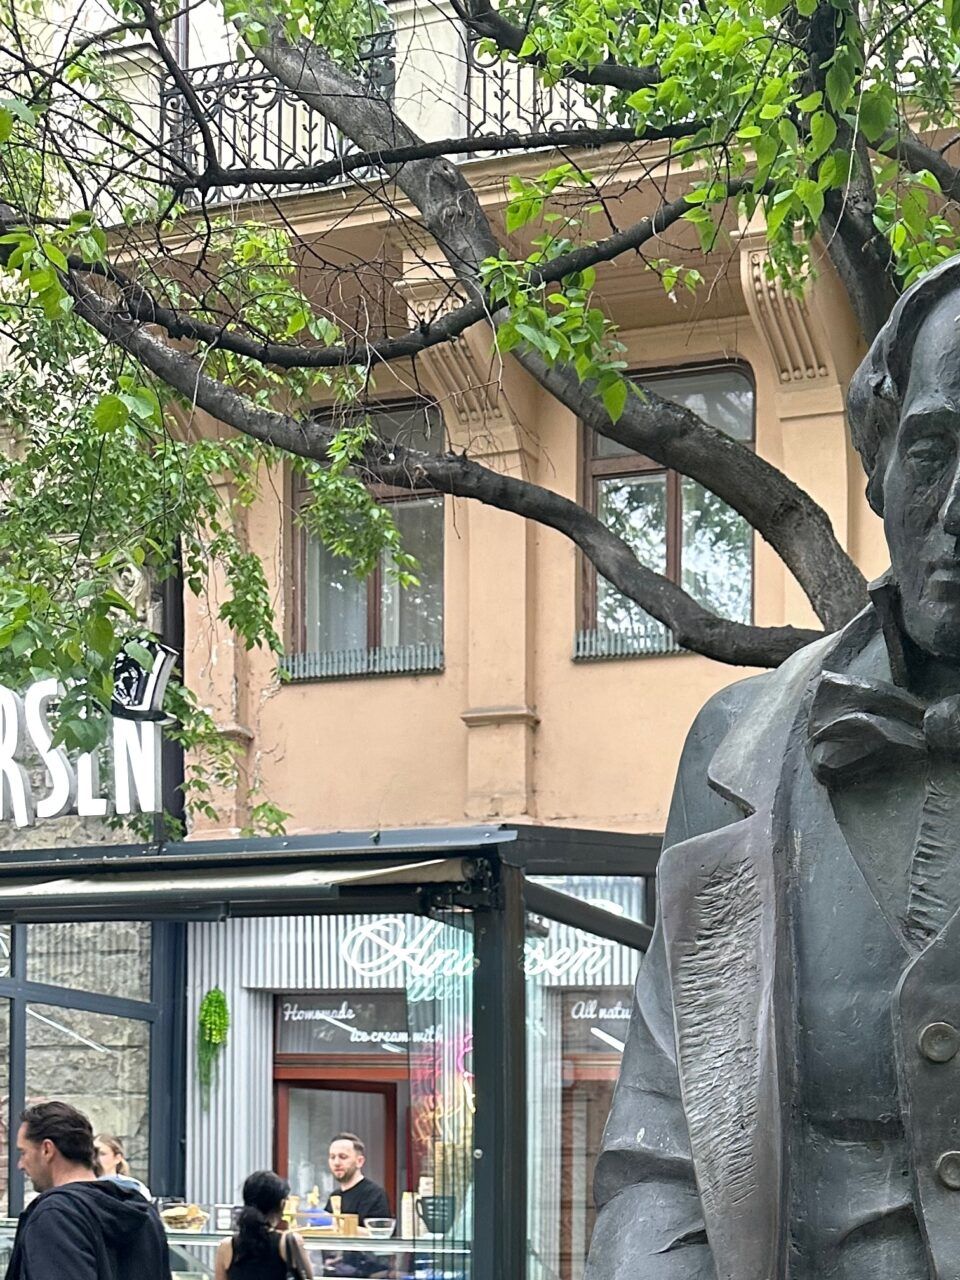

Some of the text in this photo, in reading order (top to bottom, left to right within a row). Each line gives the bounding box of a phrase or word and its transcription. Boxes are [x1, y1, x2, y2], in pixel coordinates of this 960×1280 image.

[571, 1000, 632, 1019] All natu
[371, 1030, 409, 1043] cream
[412, 1024, 444, 1043] with
